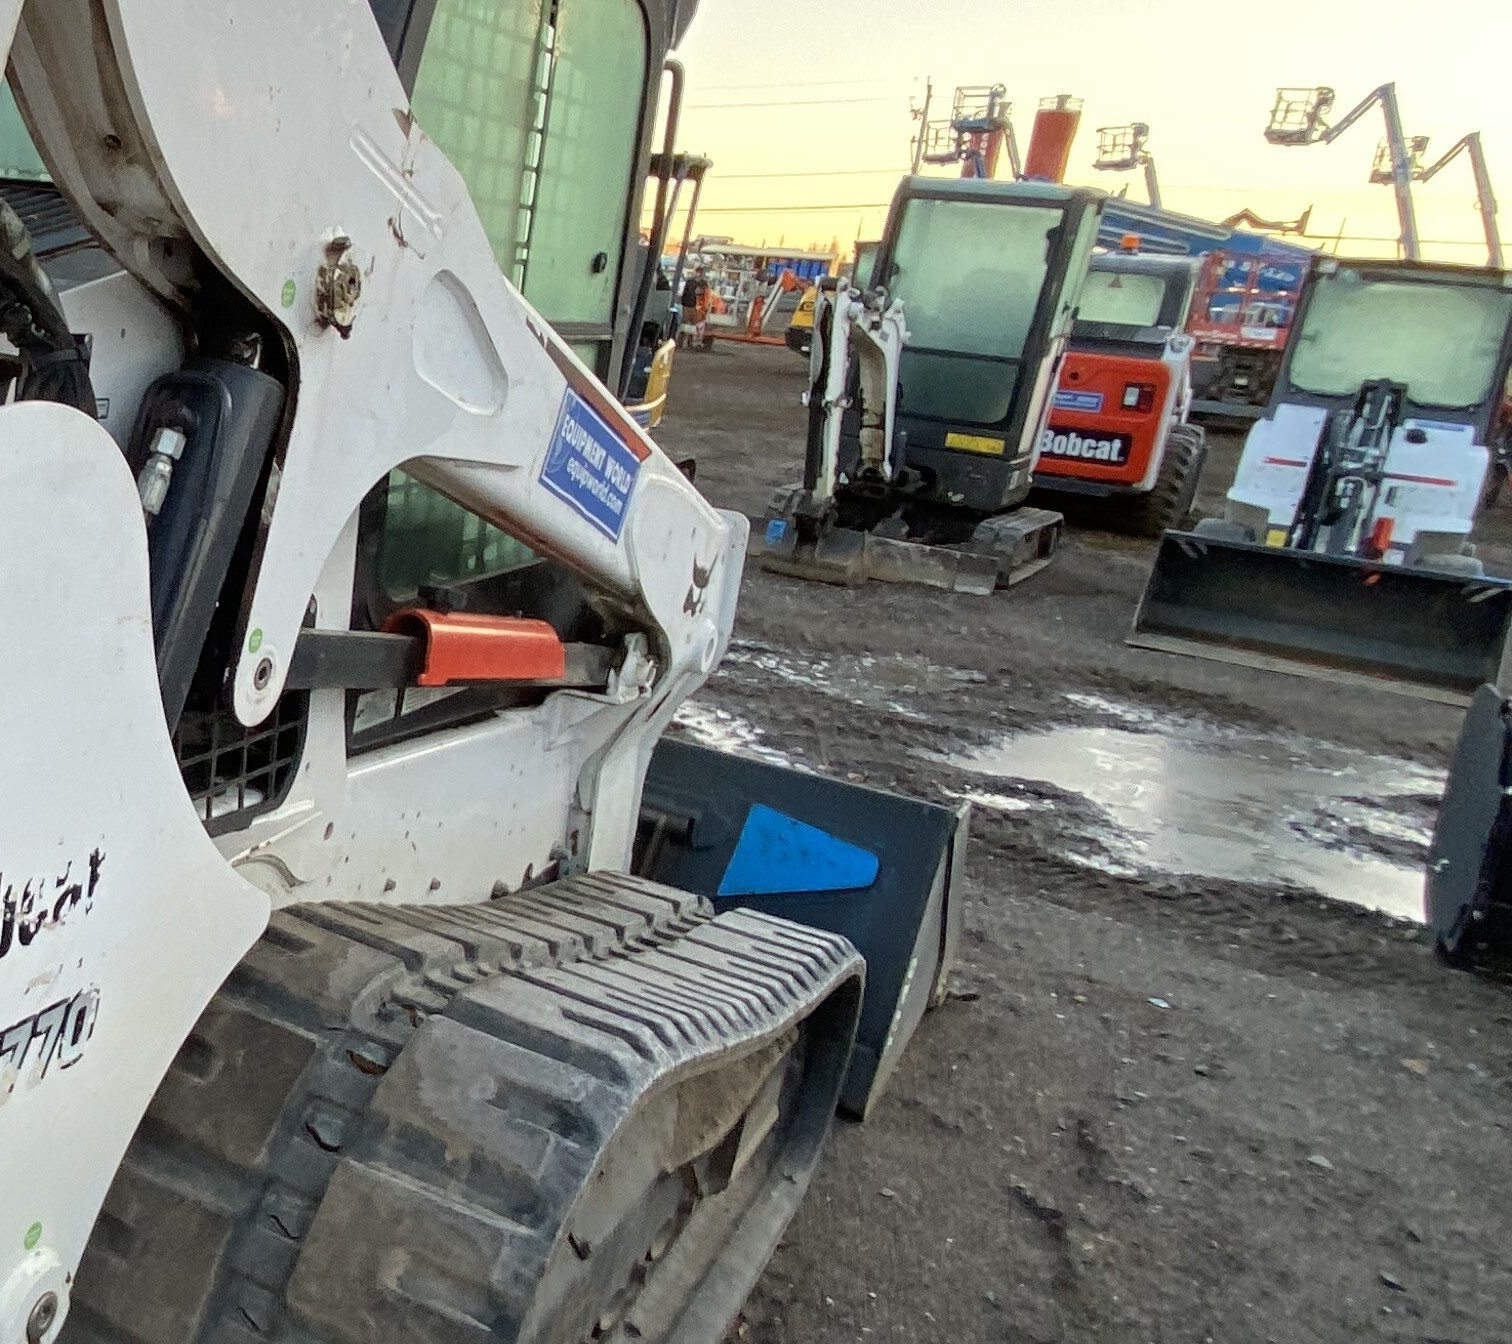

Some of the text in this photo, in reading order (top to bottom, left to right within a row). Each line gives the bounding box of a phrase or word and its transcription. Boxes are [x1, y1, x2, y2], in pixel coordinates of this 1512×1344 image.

[560, 413, 632, 495] EQUIPMENT WORLD
[1039, 428, 1123, 461] Bobcat
[566, 457, 623, 515] equipworld.com
